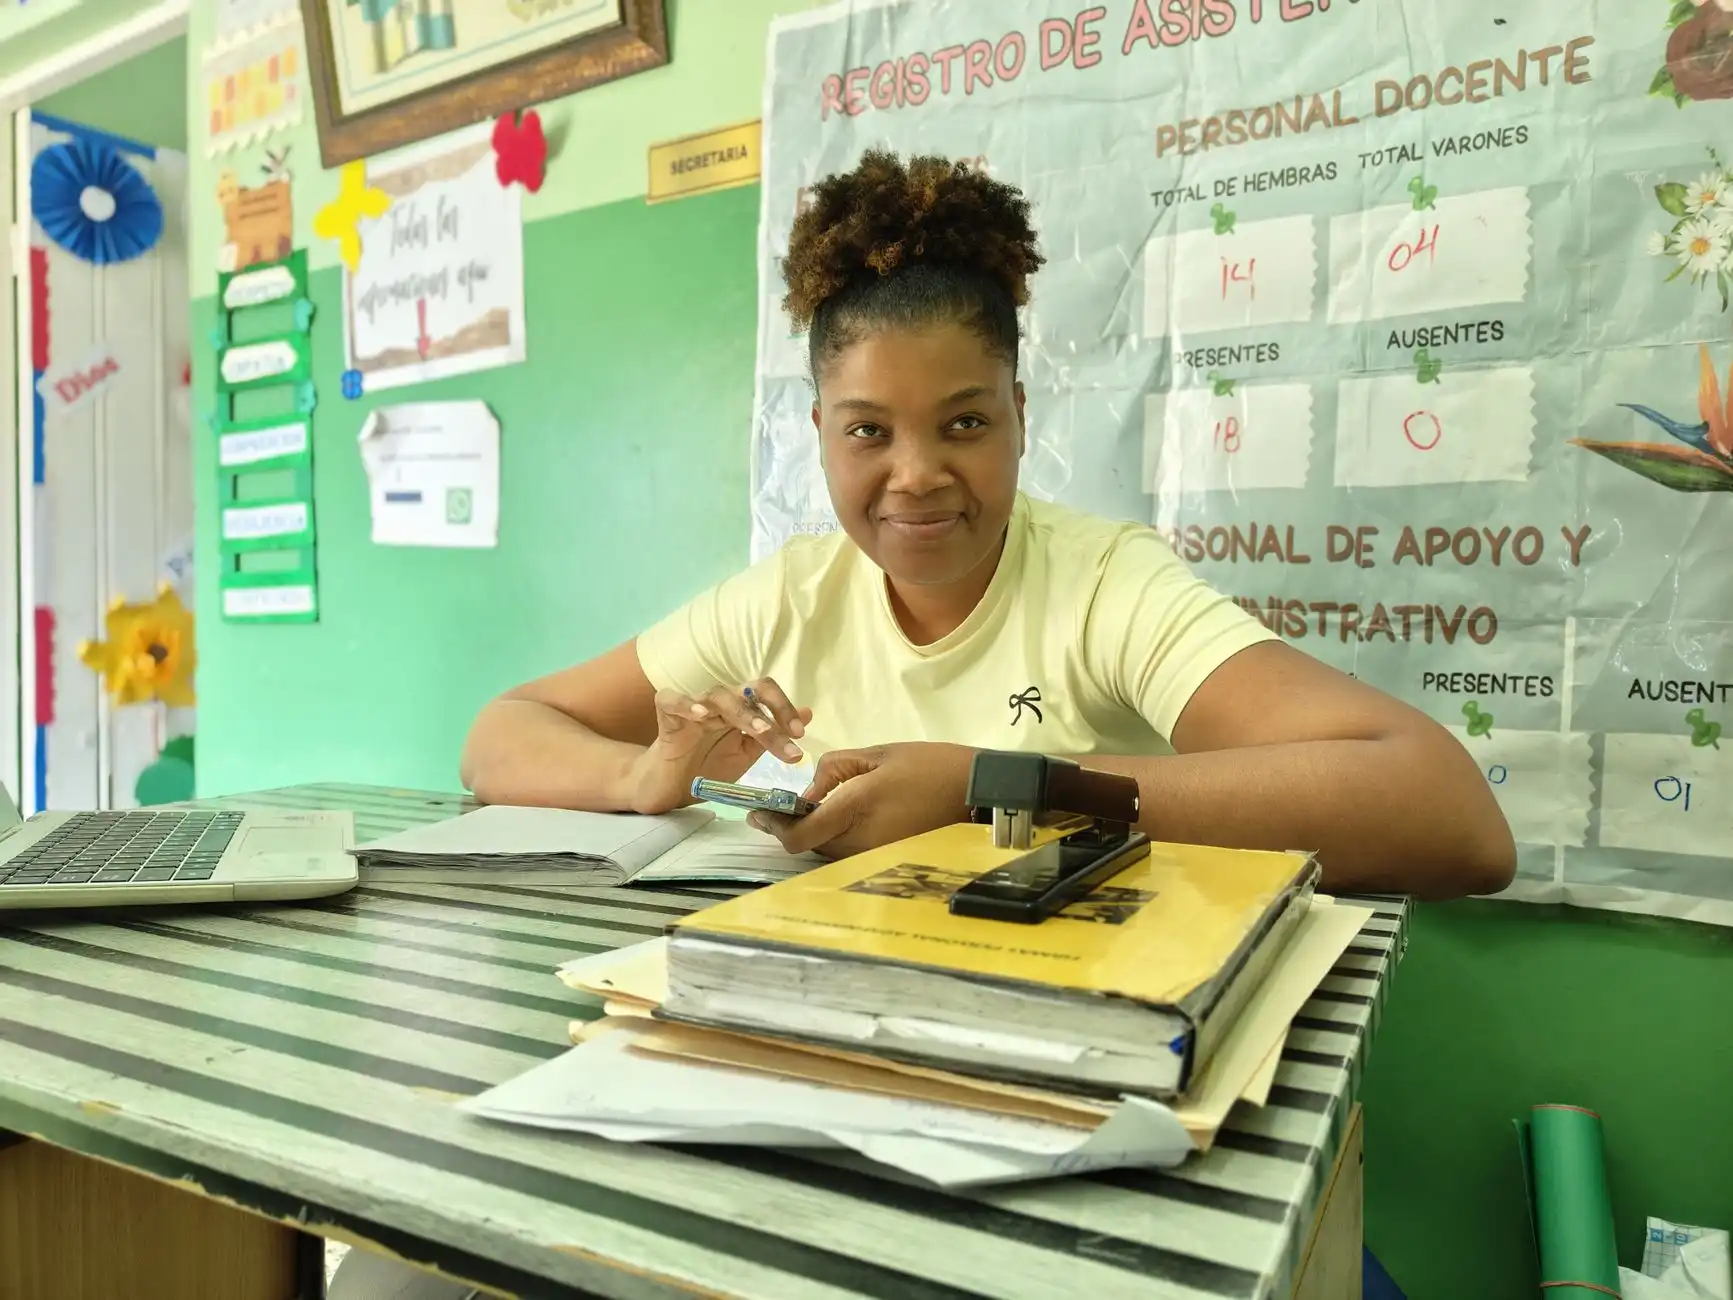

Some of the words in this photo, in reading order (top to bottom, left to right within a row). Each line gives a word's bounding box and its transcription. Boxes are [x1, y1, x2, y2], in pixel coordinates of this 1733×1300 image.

[820, 30, 1026, 122] REGISTRO
[1039, 6, 1107, 71] DE
[1121, 0, 1361, 56] ASIS
[1156, 88, 1360, 159] PERSONAL
[1374, 35, 1596, 118] DOCENTE
[670, 144, 748, 176] SECRETARIA
[1358, 143, 1424, 169] TOTAL
[1432, 125, 1529, 157] VARONES
[1150, 183, 1207, 208] TOTAL
[1213, 176, 1238, 198] DE
[1243, 161, 1338, 193] HEMBRAS
[1387, 224, 1441, 273] 04
[1220, 256, 1256, 300] 14
[1175, 342, 1281, 369] PRESENTES
[1386, 320, 1505, 350] AUSENTES
[1213, 416, 1241, 453] 18
[1170, 521, 1312, 565] SONAL
[1326, 525, 1380, 568] DE
[1392, 525, 1545, 568] APOYO
[1560, 524, 1592, 567] Y
[1231, 595, 1498, 646] NISTRATIVO
[1422, 671, 1554, 697] PRESENTES
[1628, 678, 1733, 704] AUSENT
